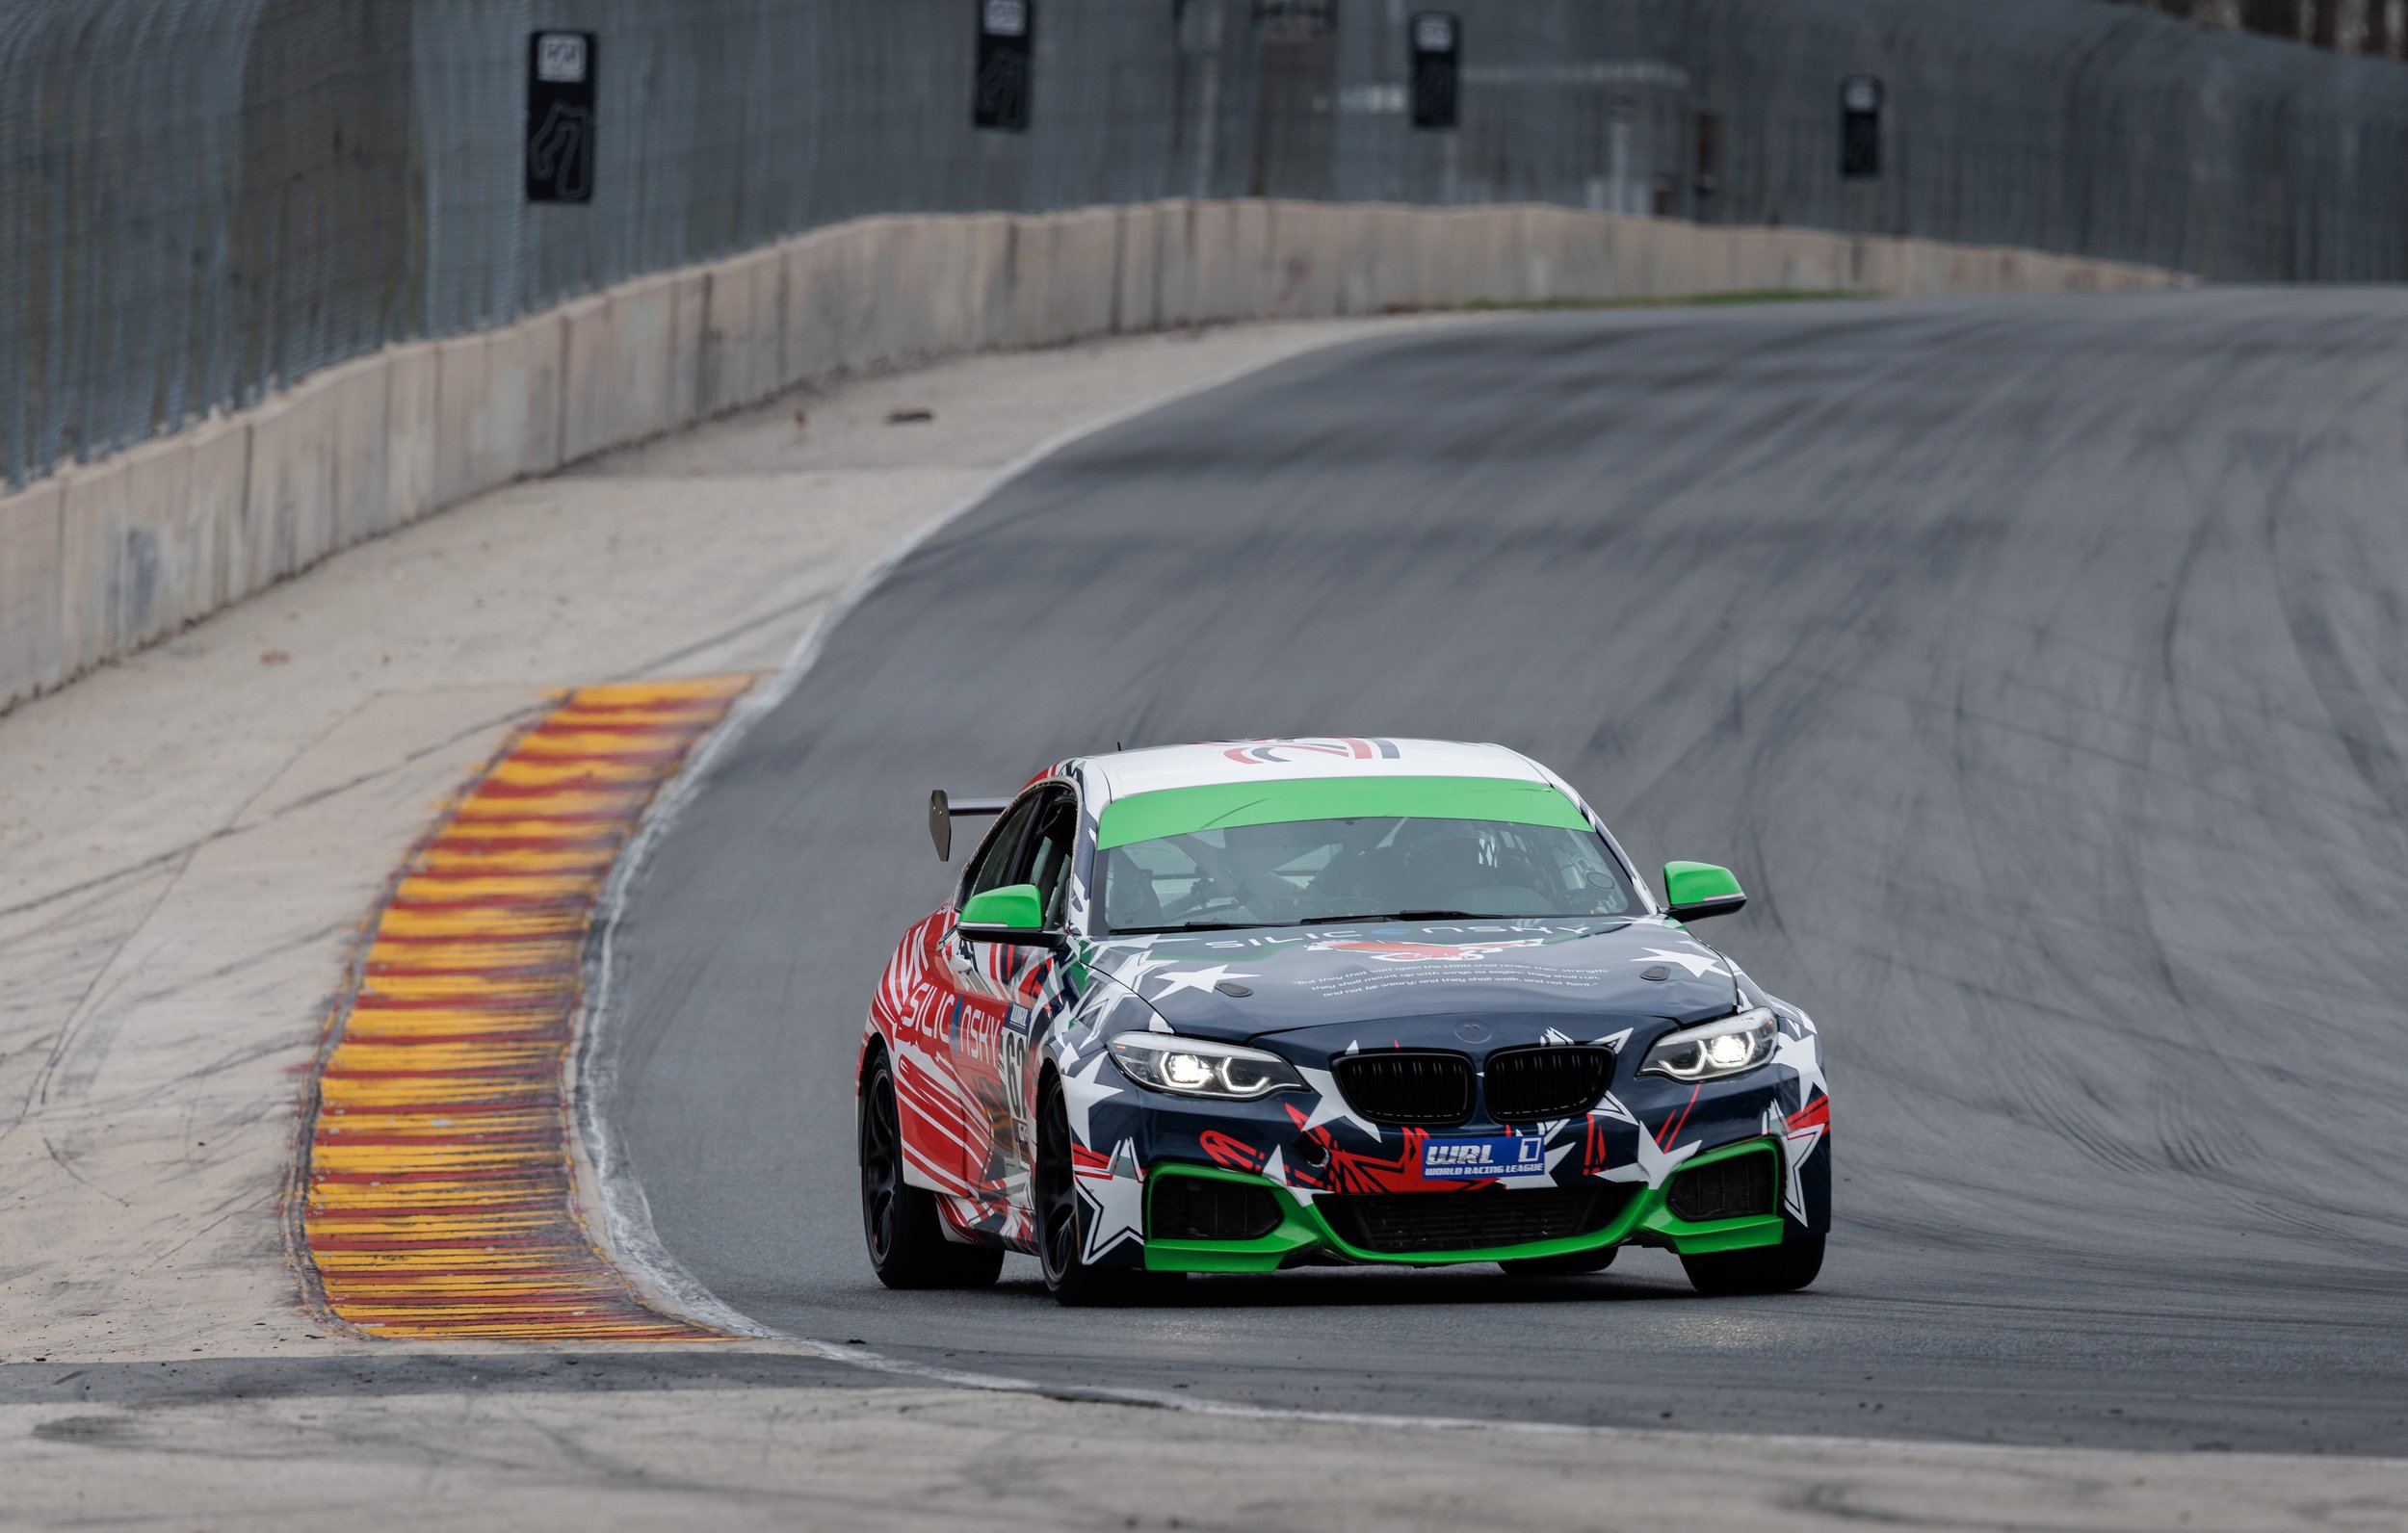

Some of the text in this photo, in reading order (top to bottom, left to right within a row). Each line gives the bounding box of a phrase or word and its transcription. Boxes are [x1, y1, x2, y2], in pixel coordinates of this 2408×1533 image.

[1426, 1144, 1494, 1166] WRL
[1425, 1162, 1544, 1176] WORLD RACING LEAGUE
